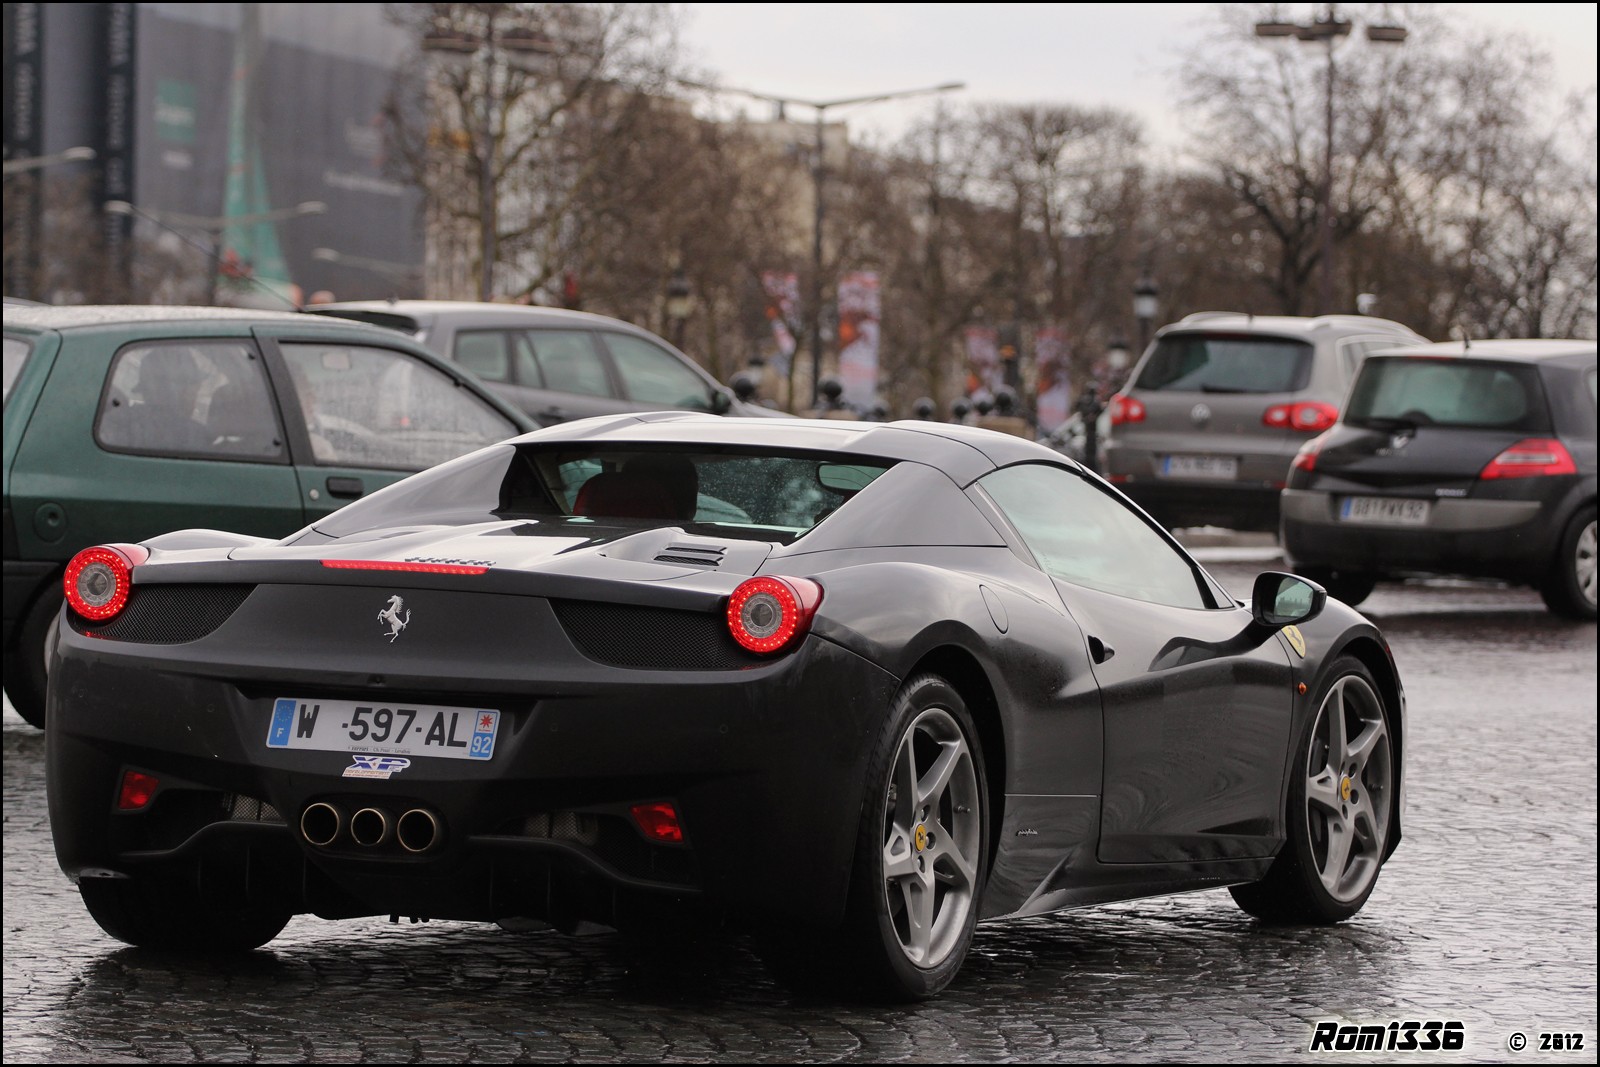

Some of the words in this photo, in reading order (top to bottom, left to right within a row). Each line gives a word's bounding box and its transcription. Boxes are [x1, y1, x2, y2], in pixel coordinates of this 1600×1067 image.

[297, 704, 320, 738] W
[276, 728, 284, 738] F
[472, 736, 491, 753] 92
